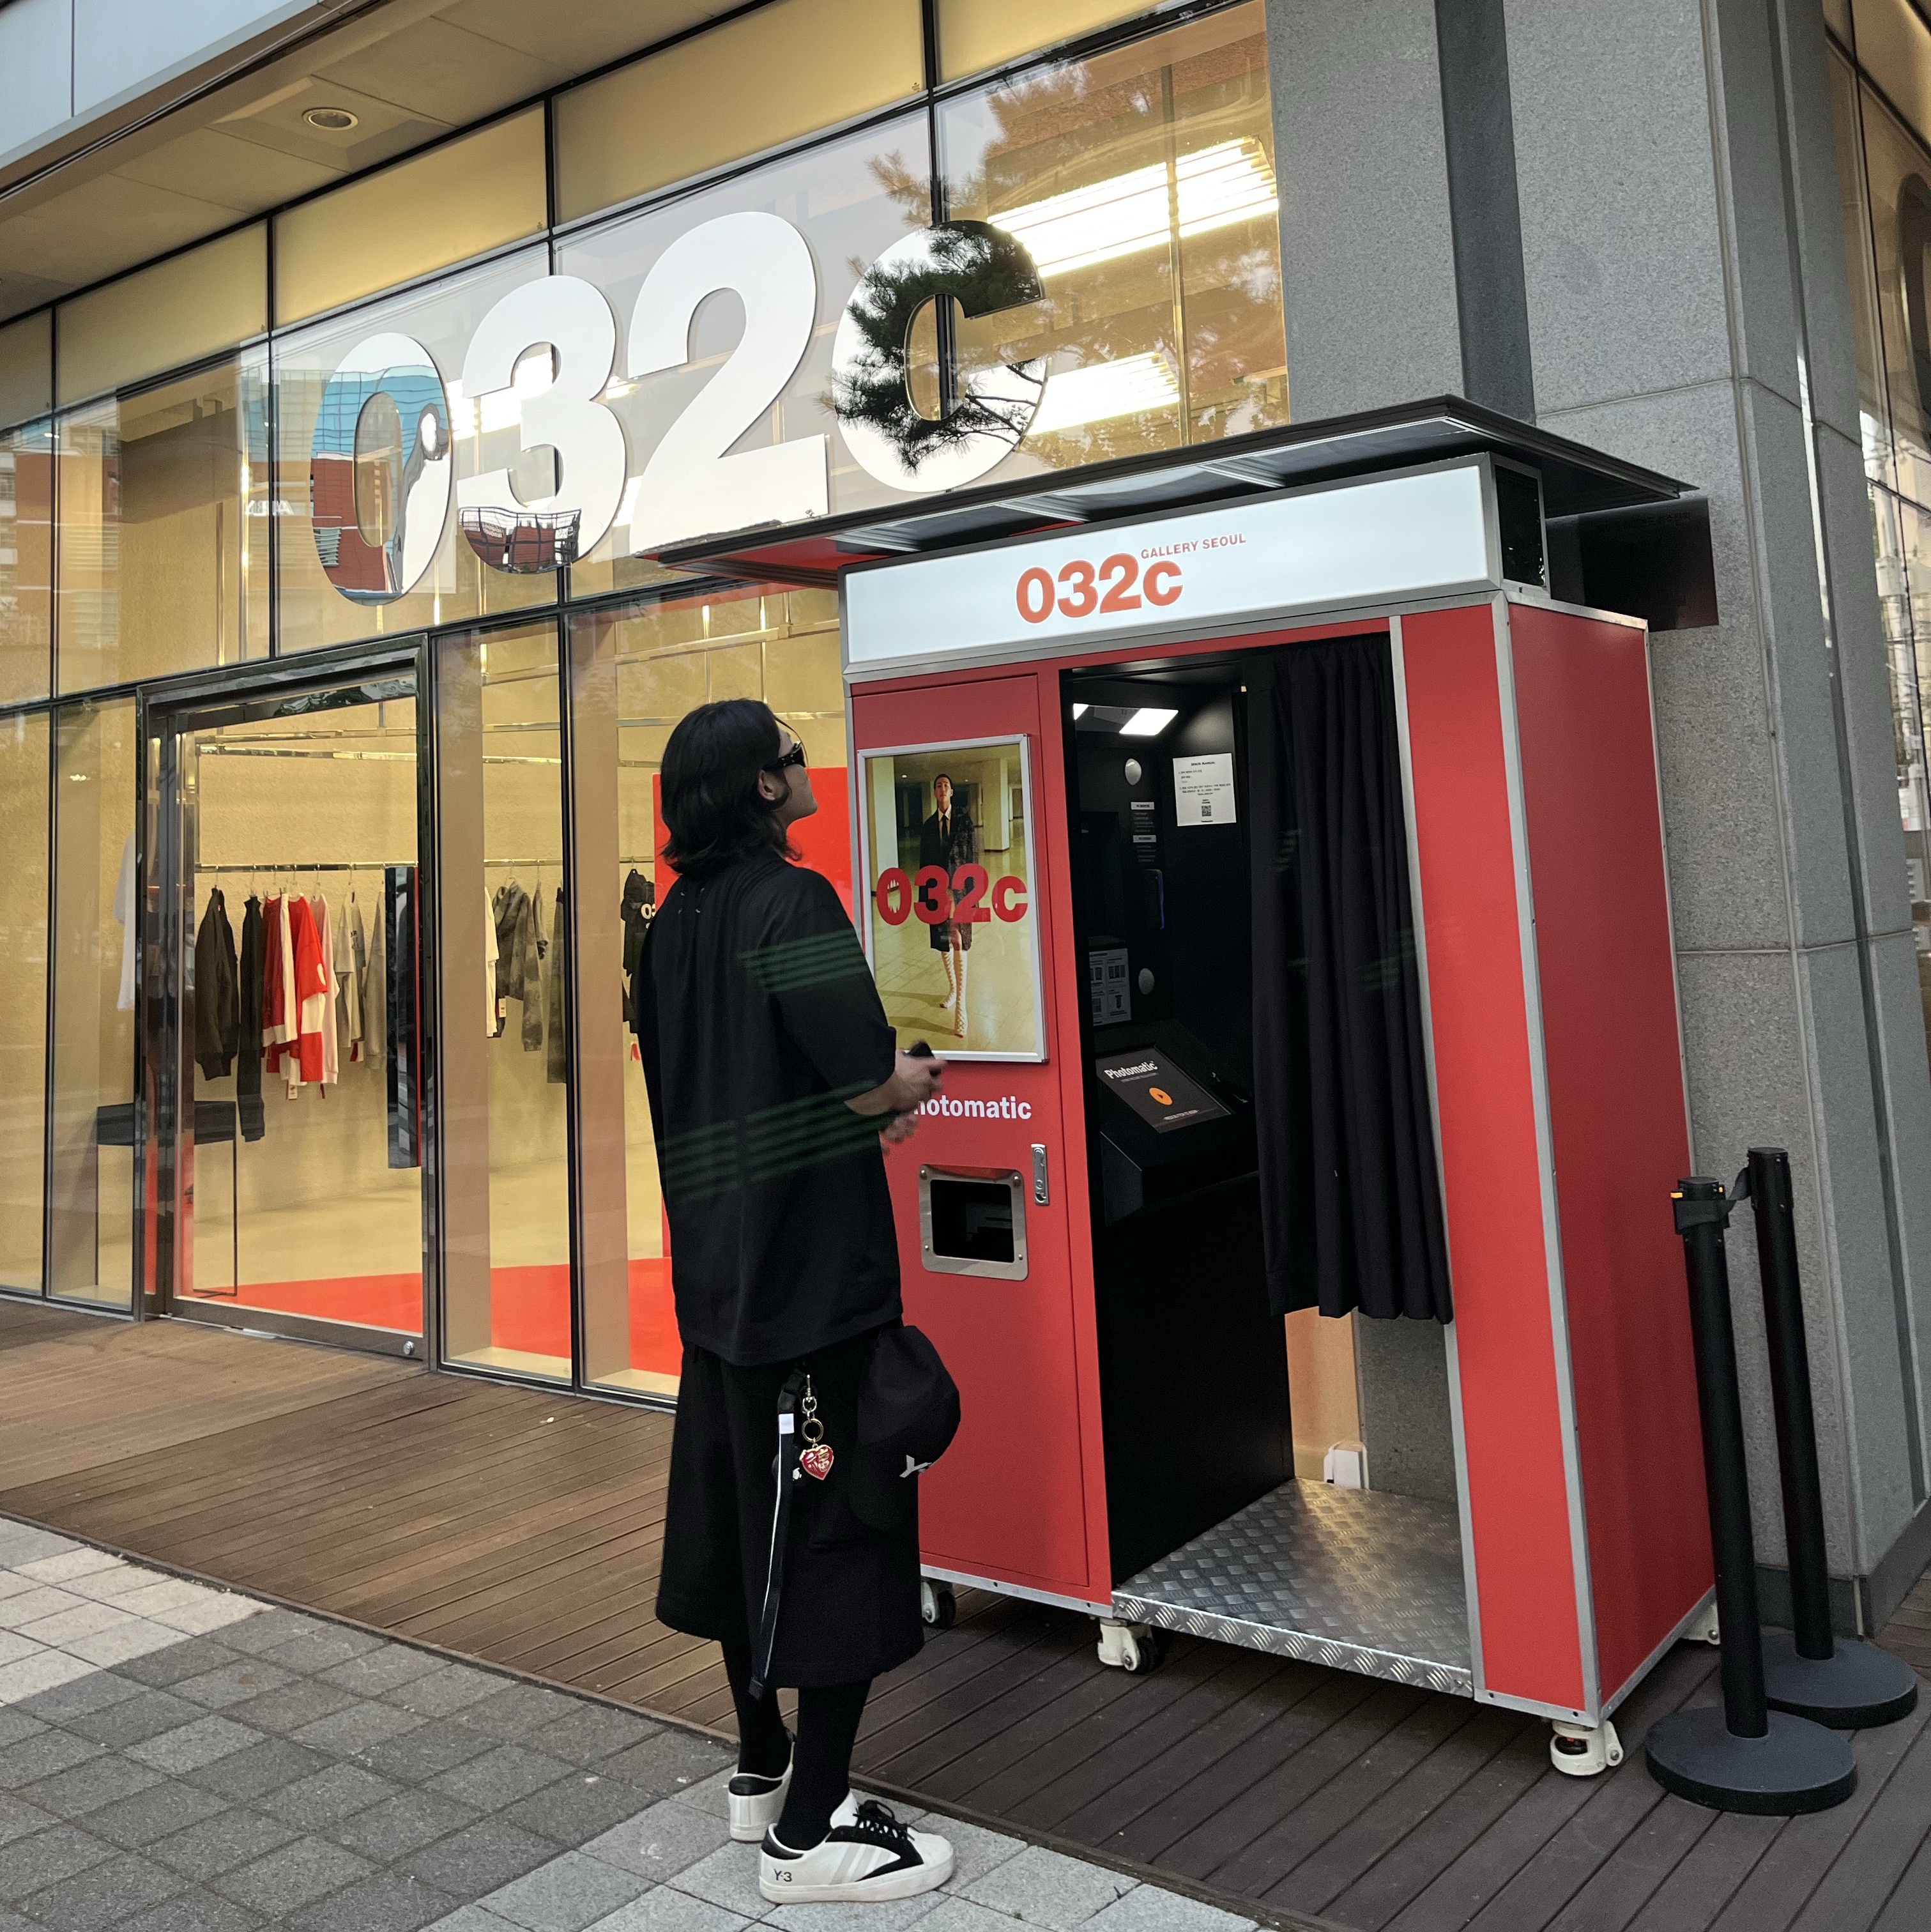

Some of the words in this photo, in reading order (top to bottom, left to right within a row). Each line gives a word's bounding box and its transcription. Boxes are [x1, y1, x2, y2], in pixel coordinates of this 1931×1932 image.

[310, 211, 1049, 606] 032c
[1140, 540, 1199, 559] GALLERY
[1202, 533, 1246, 549] SEOUL
[1016, 553, 1184, 624] 032c
[876, 862, 1028, 926] 032c
[1104, 1061, 1158, 1079] Photomatic
[774, 1868, 793, 1882] Y-3
